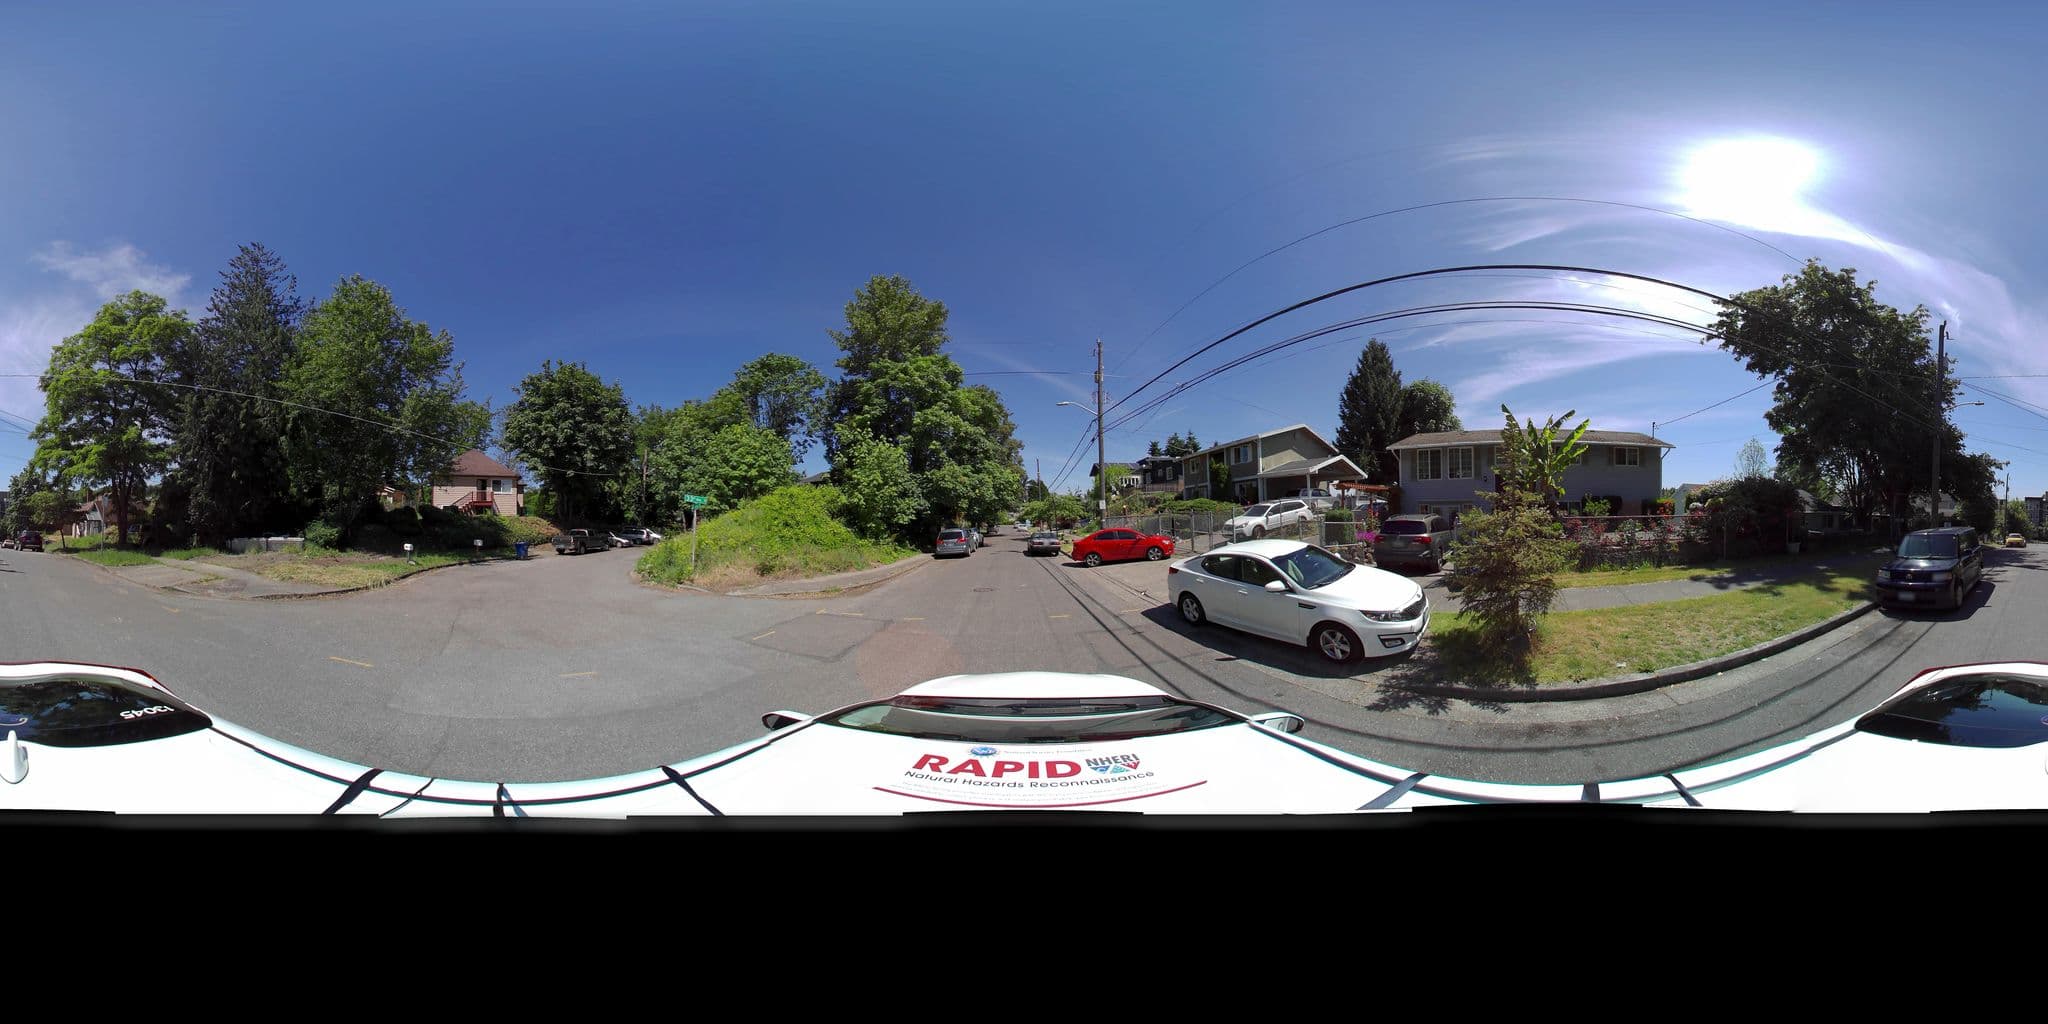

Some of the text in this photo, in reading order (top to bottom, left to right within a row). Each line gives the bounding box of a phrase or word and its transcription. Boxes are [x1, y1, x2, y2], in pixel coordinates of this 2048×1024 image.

[120, 705, 175, 720] 13045
[912, 753, 1081, 778] RAPID
[1085, 753, 1140, 767] NHERI
[904, 770, 1155, 788] Natural Hazards Reconnaissance
